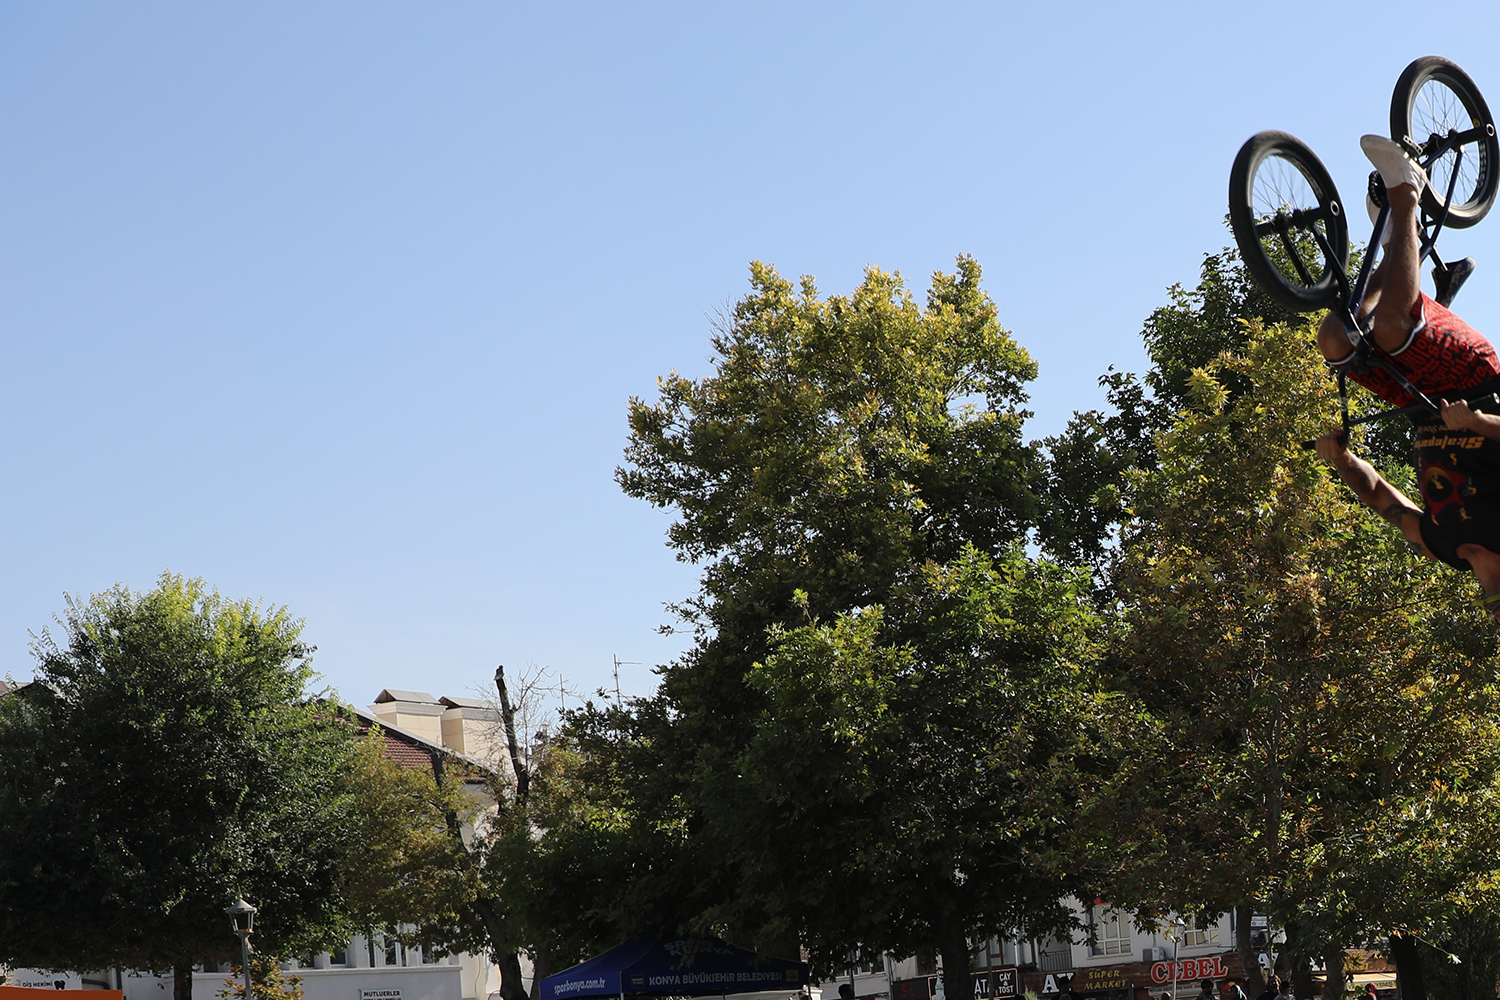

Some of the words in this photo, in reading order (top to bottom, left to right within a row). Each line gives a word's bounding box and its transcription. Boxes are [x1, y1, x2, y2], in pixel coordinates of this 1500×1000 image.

[1151, 956, 1228, 984] CEBEL
[649, 975, 681, 985] KONYA
[737, 971, 782, 982] BELEDİYESİ
[999, 972, 1011, 982] ÇAY
[998, 985, 1014, 994] TOST
[1083, 979, 1128, 991] MARKET
